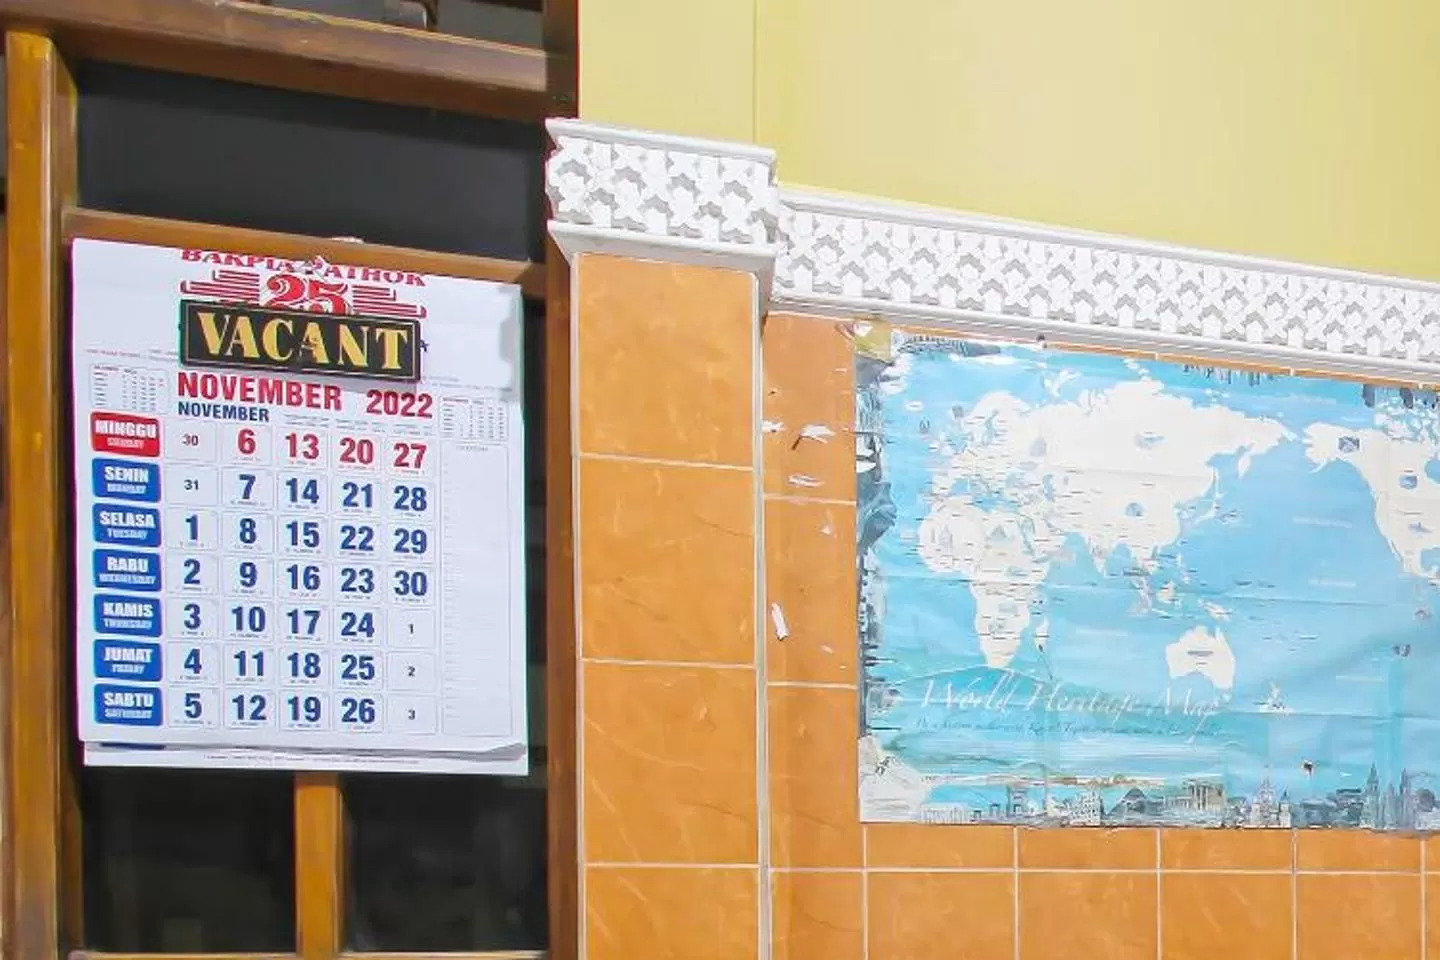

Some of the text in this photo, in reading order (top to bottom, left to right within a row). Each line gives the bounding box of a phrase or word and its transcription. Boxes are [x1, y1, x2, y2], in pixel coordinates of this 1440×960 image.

[266, 274, 348, 315] 25
[198, 312, 408, 369] VACANT
[178, 372, 342, 411] NOVEMBER
[366, 389, 433, 419] 2022
[178, 402, 269, 423] NOVEMBER
[94, 420, 157, 438] MINGGU
[182, 429, 426, 468] 30 6 13 20 27
[104, 466, 149, 483] SENIN
[184, 474, 426, 511] 31 7 14 21 28
[99, 510, 155, 528] SELASA
[186, 515, 427, 554] 1 8 15 22 29
[107, 556, 149, 573] RABU
[184, 559, 427, 596] 2 9 16 23 30
[103, 602, 153, 617] KAMIS
[184, 604, 414, 637] 3 10 17 24 1
[104, 647, 153, 663] JUMAT
[184, 649, 416, 680] 4 11 18 25 2
[104, 692, 154, 707] SABTU
[185, 693, 416, 723] 5 12 19 26 3
[919, 667, 1016, 714] World
[1145, 687, 1220, 744] Map
